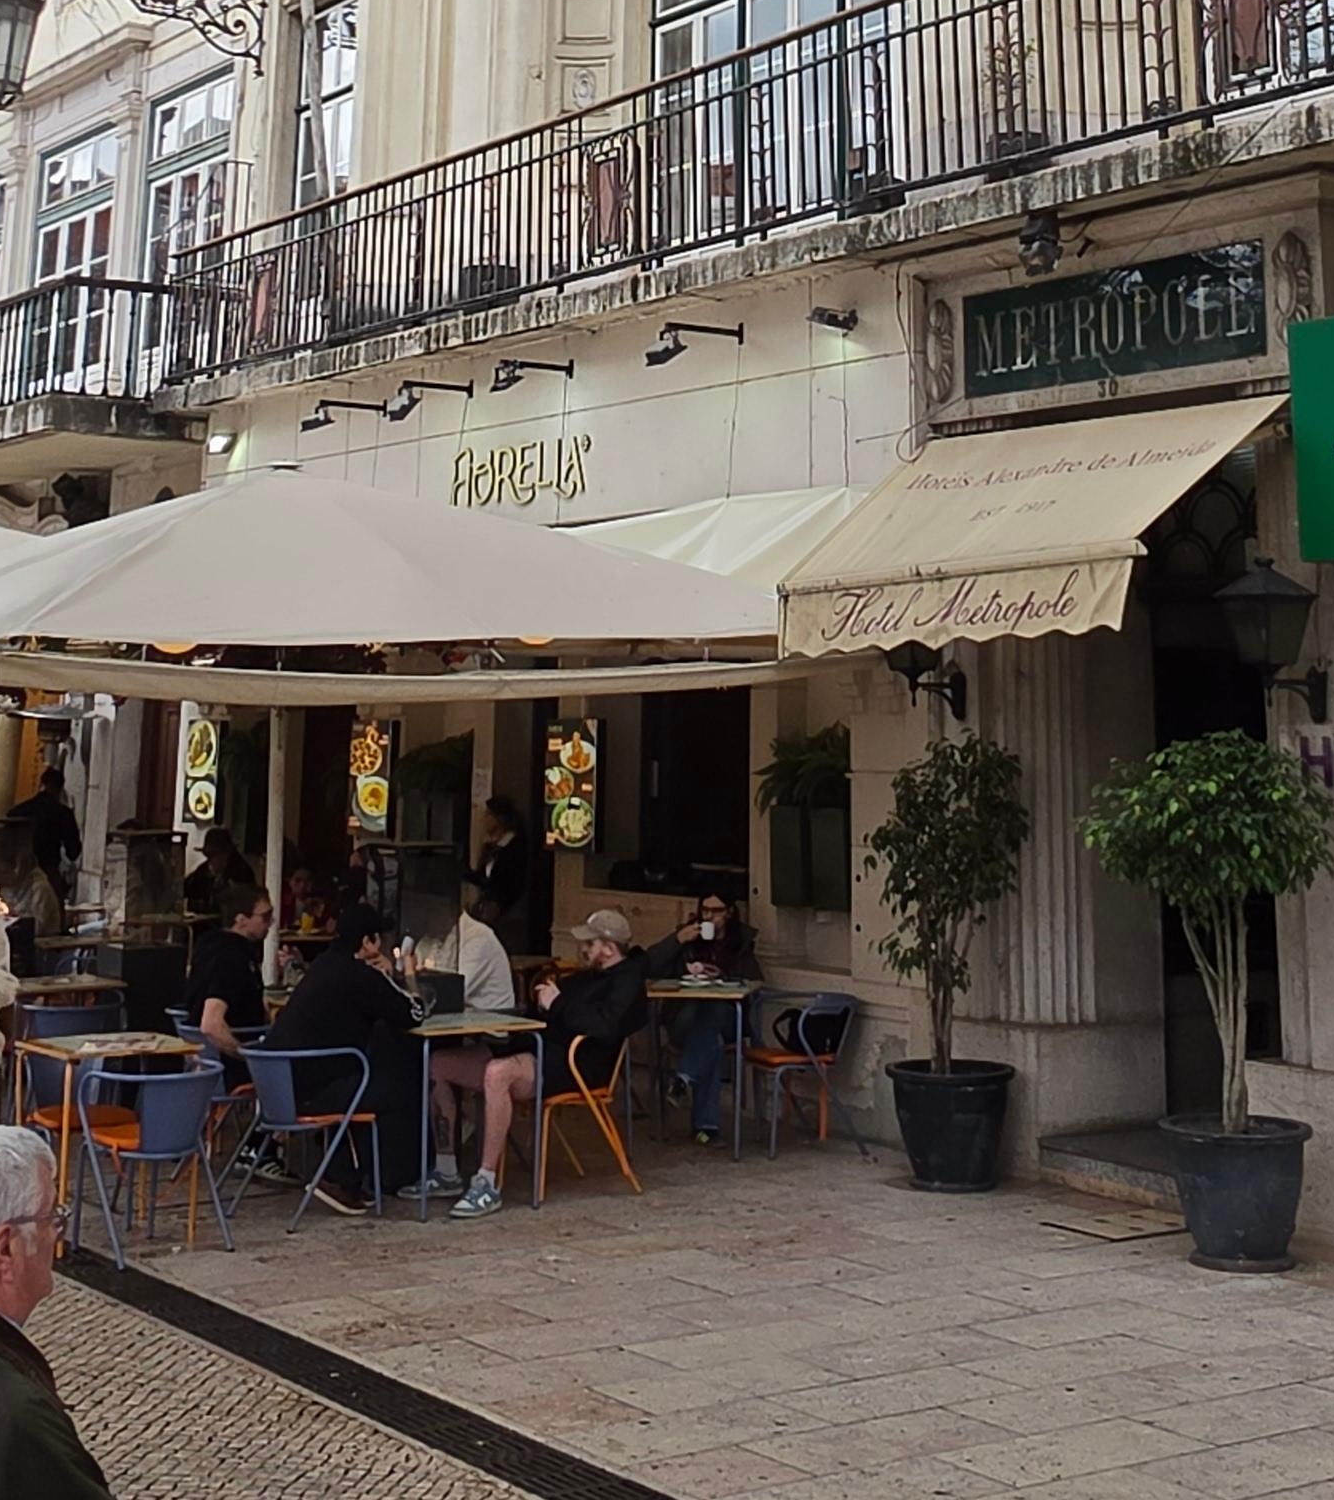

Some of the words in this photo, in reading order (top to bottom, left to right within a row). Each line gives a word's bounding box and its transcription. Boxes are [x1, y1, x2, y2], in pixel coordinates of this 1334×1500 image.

[975, 267, 1256, 377] METROPOLE
[1098, 379, 1118, 398] 30
[973, 457, 1082, 487] Alexandre
[1087, 453, 1116, 472] de
[1116, 439, 1216, 468] Almeida
[821, 587, 922, 642] Hotel
[913, 568, 1079, 632] Metropole
